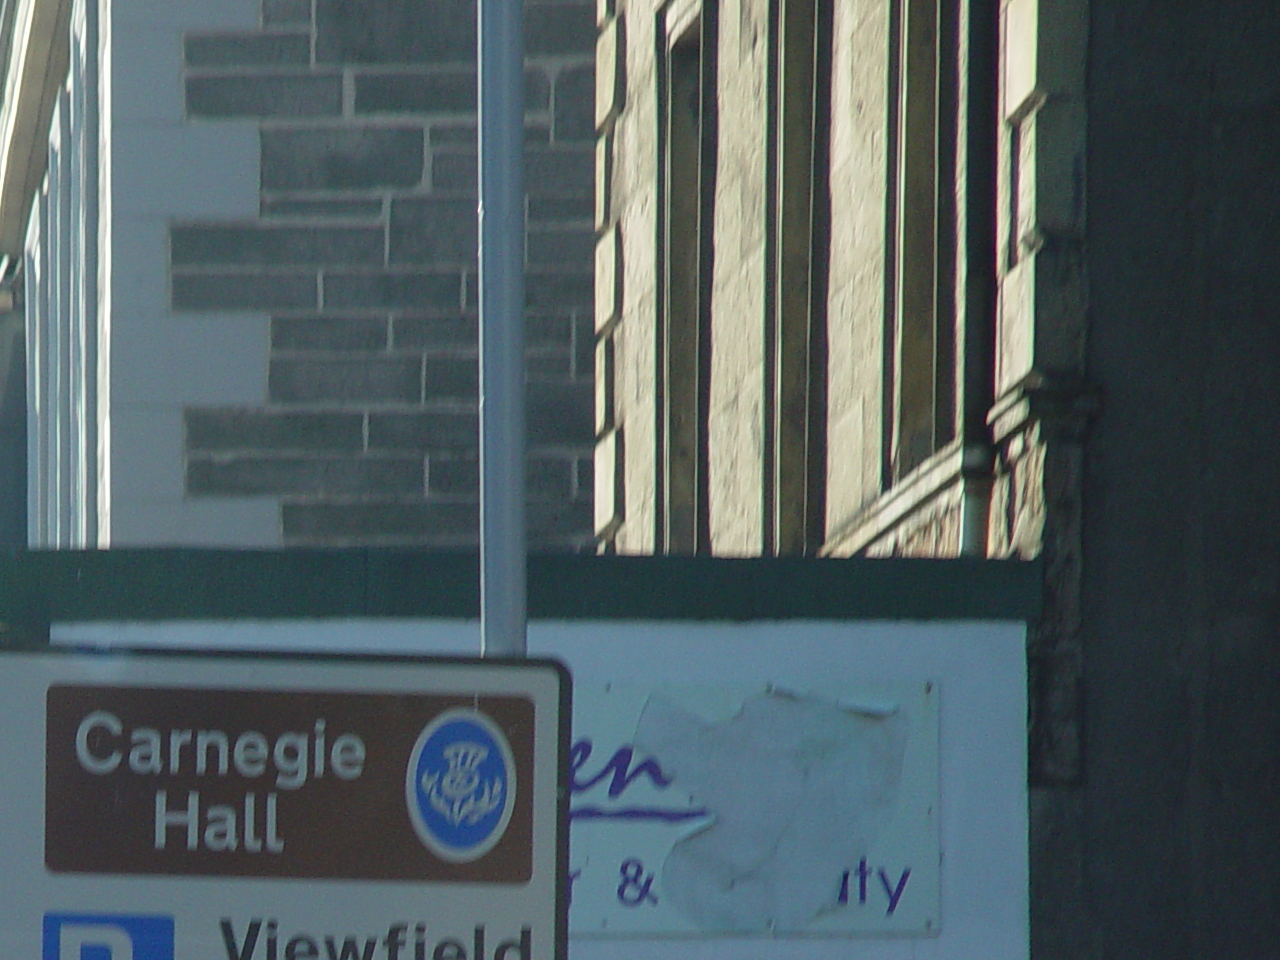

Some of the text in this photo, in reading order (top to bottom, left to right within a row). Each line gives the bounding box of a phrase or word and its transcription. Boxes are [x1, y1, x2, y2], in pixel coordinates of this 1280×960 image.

[75, 710, 366, 787] Carnegie
[154, 790, 285, 852] Hall
[616, 857, 660, 908] &
